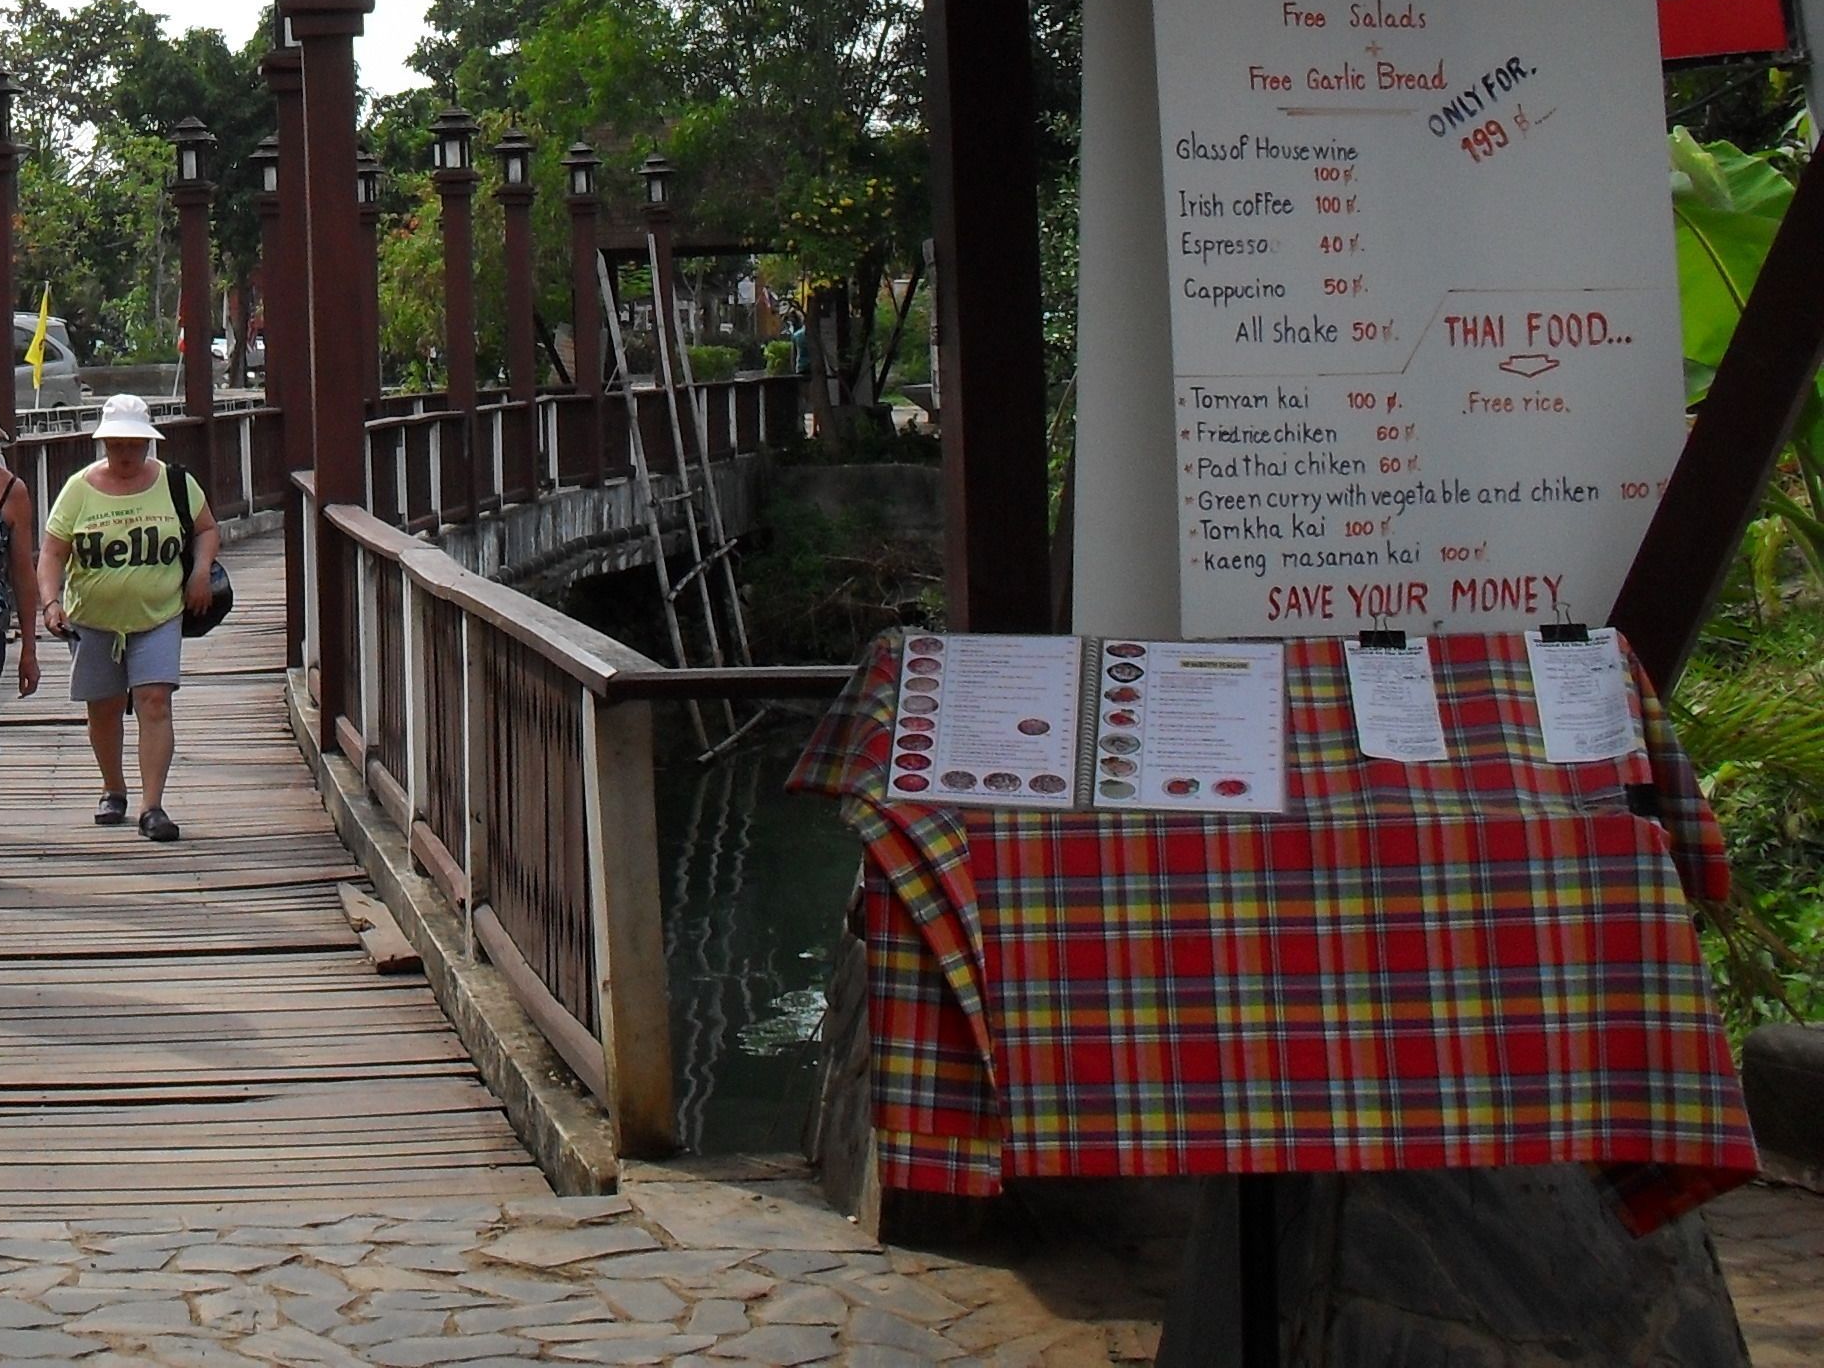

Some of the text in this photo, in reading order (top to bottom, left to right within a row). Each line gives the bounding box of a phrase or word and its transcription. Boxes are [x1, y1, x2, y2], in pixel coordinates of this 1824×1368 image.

[1283, 0, 1427, 29] Free Salads
[1249, 58, 1448, 91] Free Garlic Bread
[1428, 83, 1485, 138] ONLY
[1255, 136, 1309, 161] House
[1313, 138, 1359, 161] wine
[1461, 119, 1510, 164] 199
[1314, 167, 1340, 182] 100
[1179, 190, 1224, 217] Irish
[1232, 191, 1295, 217] coffee
[1315, 196, 1341, 214] 100
[1181, 231, 1269, 265] Espresso
[1319, 236, 1344, 254] 40
[1183, 278, 1286, 307] Cappucino
[1323, 278, 1348, 295] 50
[1235, 315, 1263, 343] All
[1351, 322, 1377, 341] 50
[1443, 314, 1505, 348] THAI
[1278, 386, 1309, 409] kai
[1347, 392, 1376, 409] 100
[1275, 422, 1338, 444] chiken
[1376, 425, 1400, 441] 60
[1294, 451, 1367, 476] chiken
[1379, 457, 1401, 475] 60
[1198, 490, 1262, 511] Green
[1266, 496, 1322, 514] curry
[1326, 483, 1367, 508] with
[1477, 480, 1522, 504] and
[1531, 476, 1600, 502] chiken
[1620, 482, 1650, 501] 100
[1292, 512, 1327, 537] kai
[1344, 520, 1374, 537] 100
[74, 526, 181, 569] Hello
[1386, 540, 1421, 564] kai
[1440, 546, 1468, 563] 100
[1267, 573, 1564, 621] SAVE YOUR MONEY
